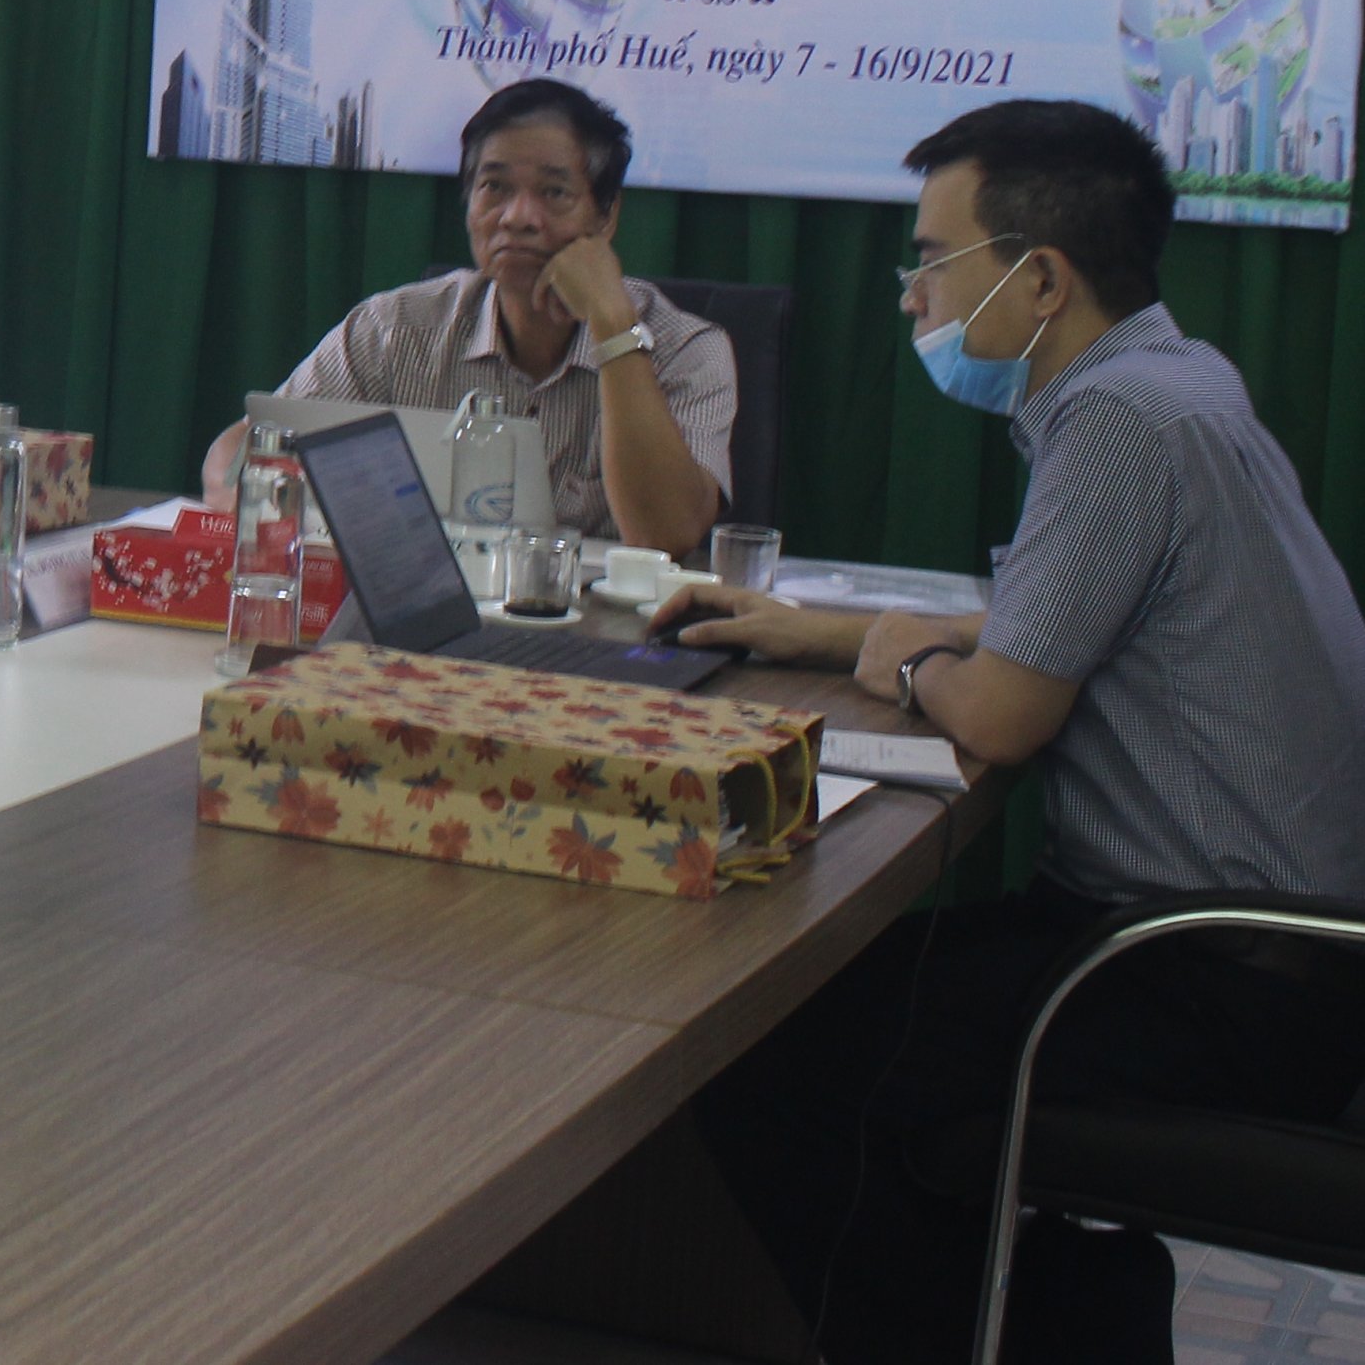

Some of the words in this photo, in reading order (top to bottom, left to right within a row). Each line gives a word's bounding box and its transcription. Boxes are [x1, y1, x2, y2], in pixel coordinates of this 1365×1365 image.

[436, 24, 536, 63] Thành
[545, 26, 616, 72] phố
[618, 29, 698, 77] Huế,
[706, 39, 785, 84] ngày
[796, 42, 816, 77] 7
[850, 44, 1014, 85] 16/9/2021
